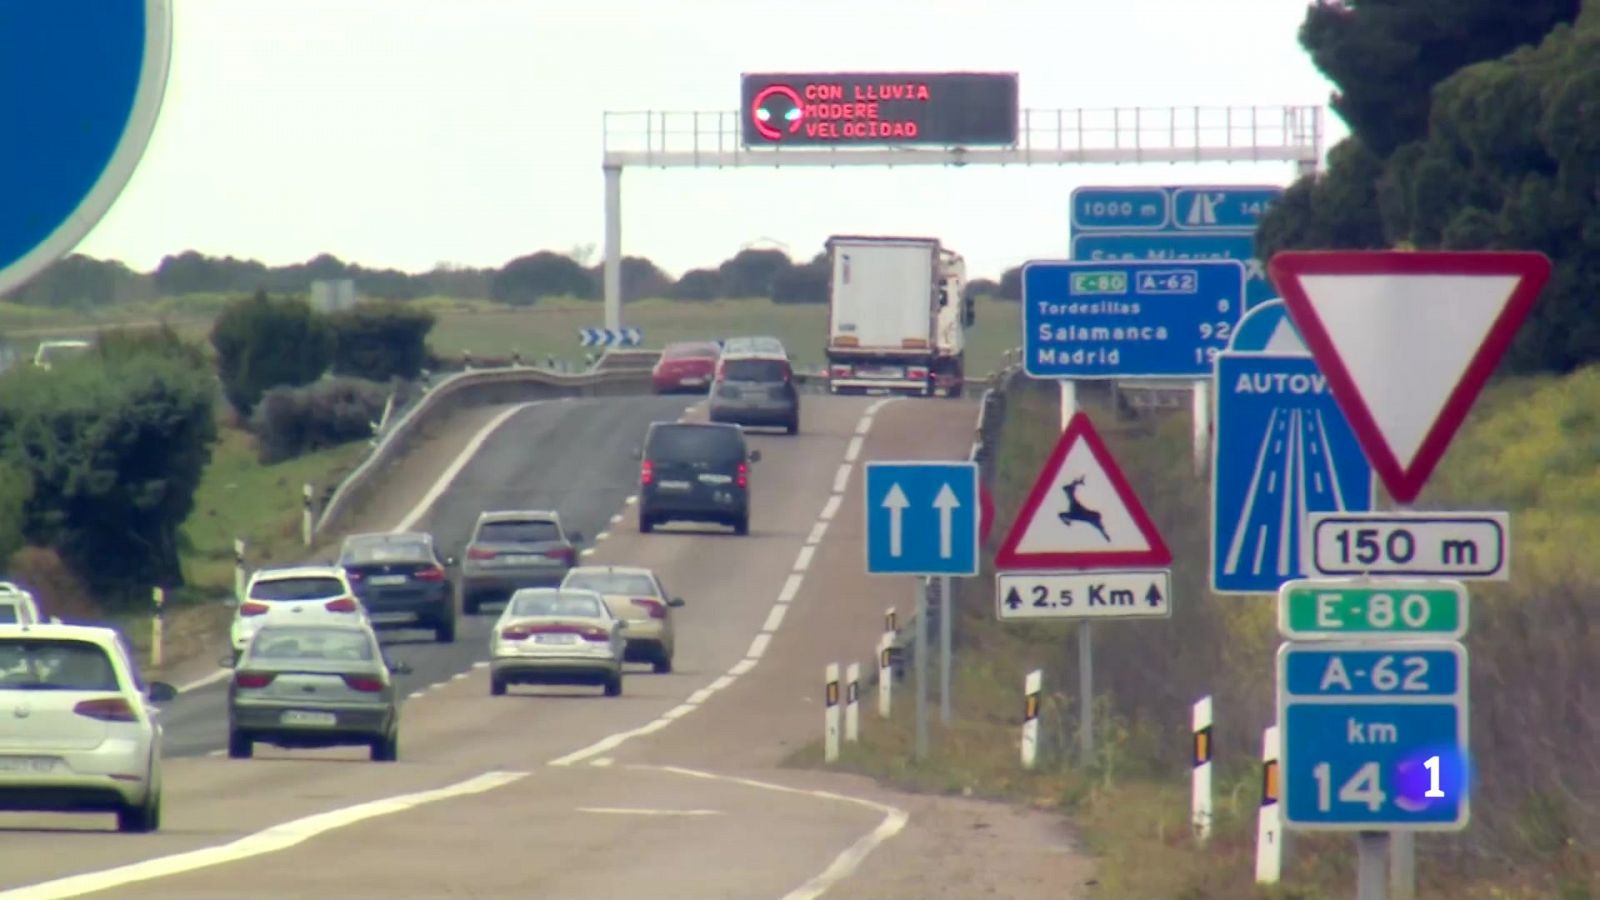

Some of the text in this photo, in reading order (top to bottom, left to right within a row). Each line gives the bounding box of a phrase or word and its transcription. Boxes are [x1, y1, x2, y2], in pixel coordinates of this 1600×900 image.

[805, 84, 929, 100] CON LLUVIA
[805, 103, 879, 119] MODERE
[805, 121, 918, 137] VELOCIDAD
[1084, 202, 1156, 216] 1000 m
[1075, 275, 1122, 290] E-80
[1142, 273, 1193, 289] A-62
[1038, 299, 1230, 315] Tordesillas 8
[1039, 321, 1230, 341] Salamanca 92
[1039, 346, 1218, 365] Madrid 19
[1234, 372, 1334, 395] AUTOV
[1336, 529, 1479, 565] 150 m
[1032, 584, 1135, 608] 2.5 Km
[1316, 593, 1430, 628] E-80
[1319, 656, 1430, 691] A-62
[1347, 717, 1397, 744] km
